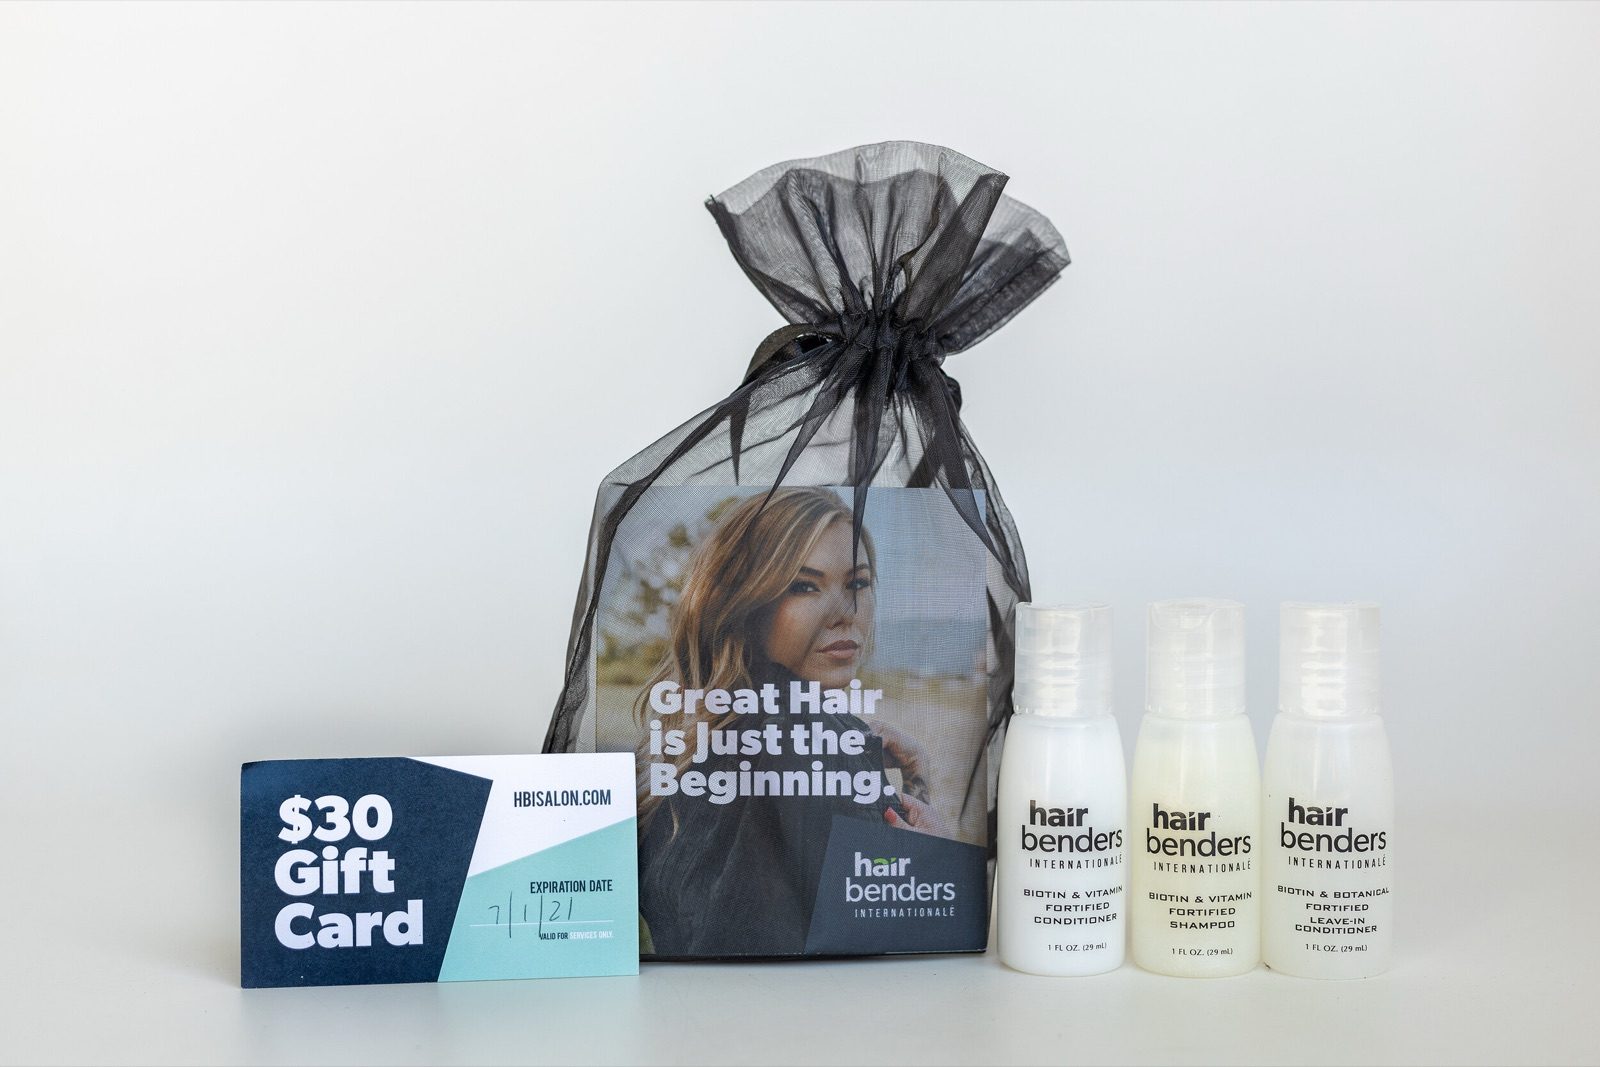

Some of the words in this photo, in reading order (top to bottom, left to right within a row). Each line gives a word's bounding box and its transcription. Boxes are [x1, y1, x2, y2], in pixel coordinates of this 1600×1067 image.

[650, 680, 780, 715] Great
[790, 678, 883, 715] Hair
[649, 719, 686, 756] is
[692, 722, 782, 764] Just
[790, 722, 865, 756] the
[649, 760, 896, 805] Beginning.
[514, 789, 611, 808] HBISALON.COM
[278, 794, 393, 844] $30
[1029, 799, 1088, 827] hair
[1153, 803, 1211, 831] hair
[1288, 797, 1348, 827] hair
[1021, 825, 1122, 852] benders
[1146, 828, 1251, 857] benders
[1280, 822, 1386, 853] benders
[274, 845, 395, 896] Gift
[854, 852, 911, 877] hair
[530, 880, 586, 894] EXPIRATION
[589, 879, 613, 892] DATE
[845, 876, 956, 902] benders
[1023, 889, 1066, 899] BIOTIN
[1085, 885, 1123, 898] VITAMIN
[1149, 892, 1189, 903] BIOTIN
[1208, 892, 1252, 903] VITAMIN
[1277, 885, 1315, 897] BIOTIN
[1334, 887, 1389, 899] BOTANICAL
[1046, 902, 1110, 912] FORTIFIED
[1169, 908, 1236, 916] FORTIFIED
[1306, 903, 1369, 912] FORTIFIED
[274, 899, 424, 950] Card
[1034, 913, 1117, 925] CONDITIONER
[1170, 921, 1235, 929] SHAMPOO
[1295, 924, 1377, 934] CONDITIONER
[1310, 917, 1365, 925] LEAVE-IN
[539, 932, 556, 941] VALID
[557, 932, 569, 940] FOR
[570, 931, 597, 940] SERVICES
[1341, 945, 1353, 953] (29
